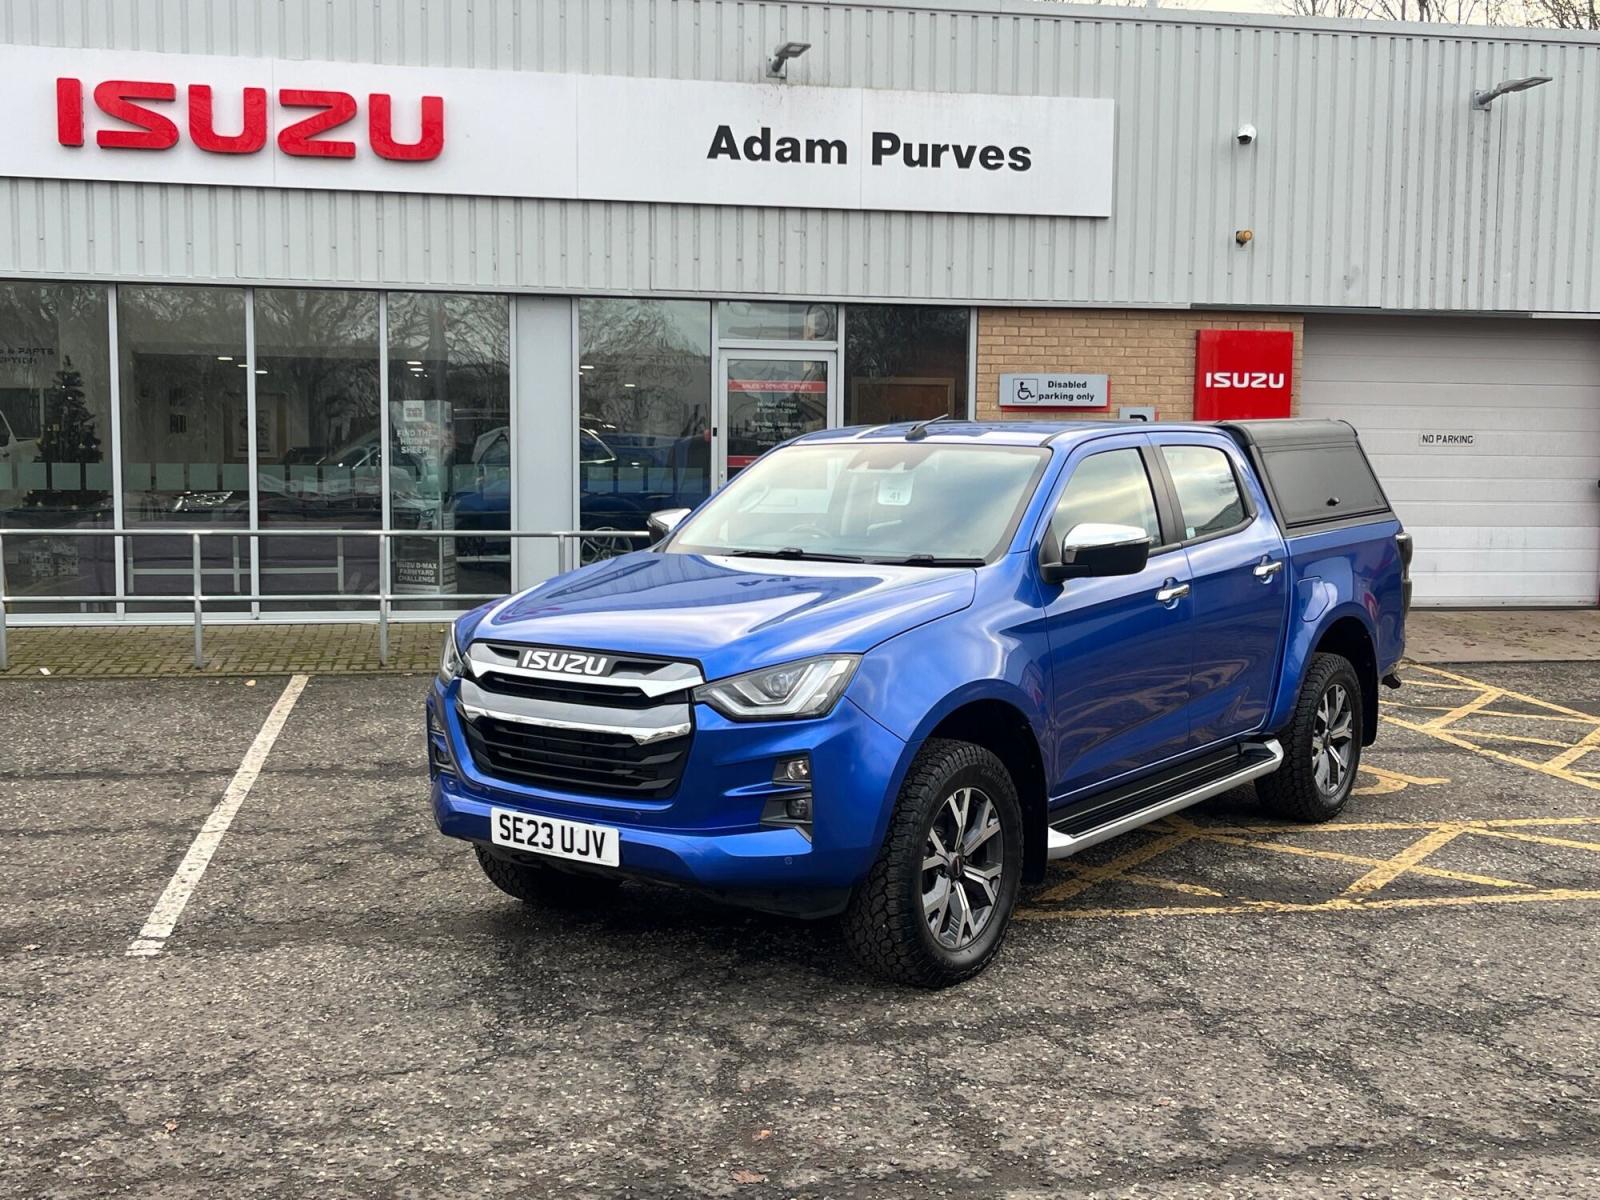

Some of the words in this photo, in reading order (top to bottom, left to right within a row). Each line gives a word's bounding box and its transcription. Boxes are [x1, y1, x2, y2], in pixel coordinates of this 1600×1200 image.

[56, 77, 444, 162] ISUZU
[707, 124, 847, 164] Adam
[871, 131, 1032, 172] Purves
[1048, 380, 1087, 389] Disabled
[1205, 372, 1284, 389] ISUZU
[1039, 391, 1073, 401] parking
[1076, 392, 1095, 401] only
[1422, 434, 1434, 443] NO
[1436, 434, 1475, 444] PARKING
[522, 650, 608, 675] ISUZU
[499, 814, 554, 850] SE23
[561, 825, 606, 859] UJV
